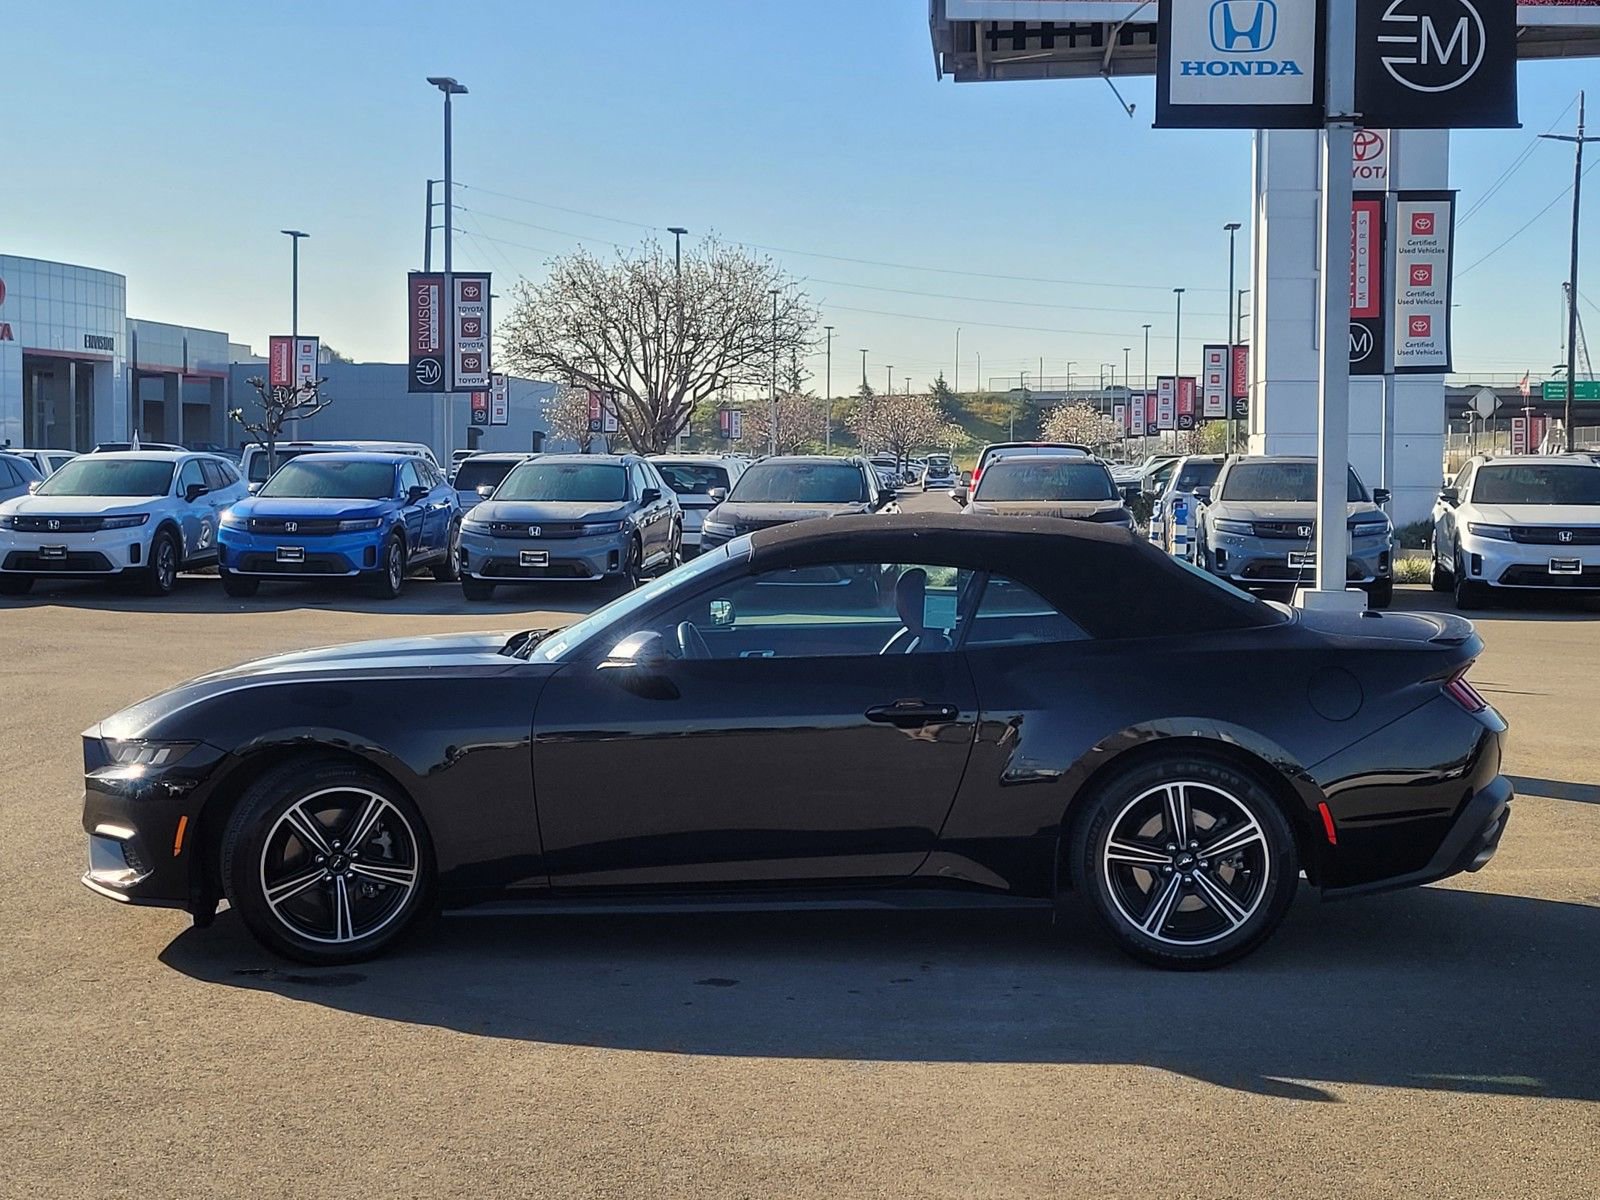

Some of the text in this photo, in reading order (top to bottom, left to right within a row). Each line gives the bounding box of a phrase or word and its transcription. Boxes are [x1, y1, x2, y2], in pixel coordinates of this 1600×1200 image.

[1180, 60, 1304, 77] HONDA
[1352, 166, 1387, 179] YOT
[1407, 238, 1438, 247] Certified
[1398, 247, 1417, 255] Used
[1358, 219, 1368, 301] MOTORS
[1405, 290, 1436, 298] Certified
[1397, 298, 1444, 306] Used Vehicles
[457, 305, 485, 314] TOYOTA
[417, 284, 430, 350] ENVISION
[457, 377, 485, 385] TOYOTA
